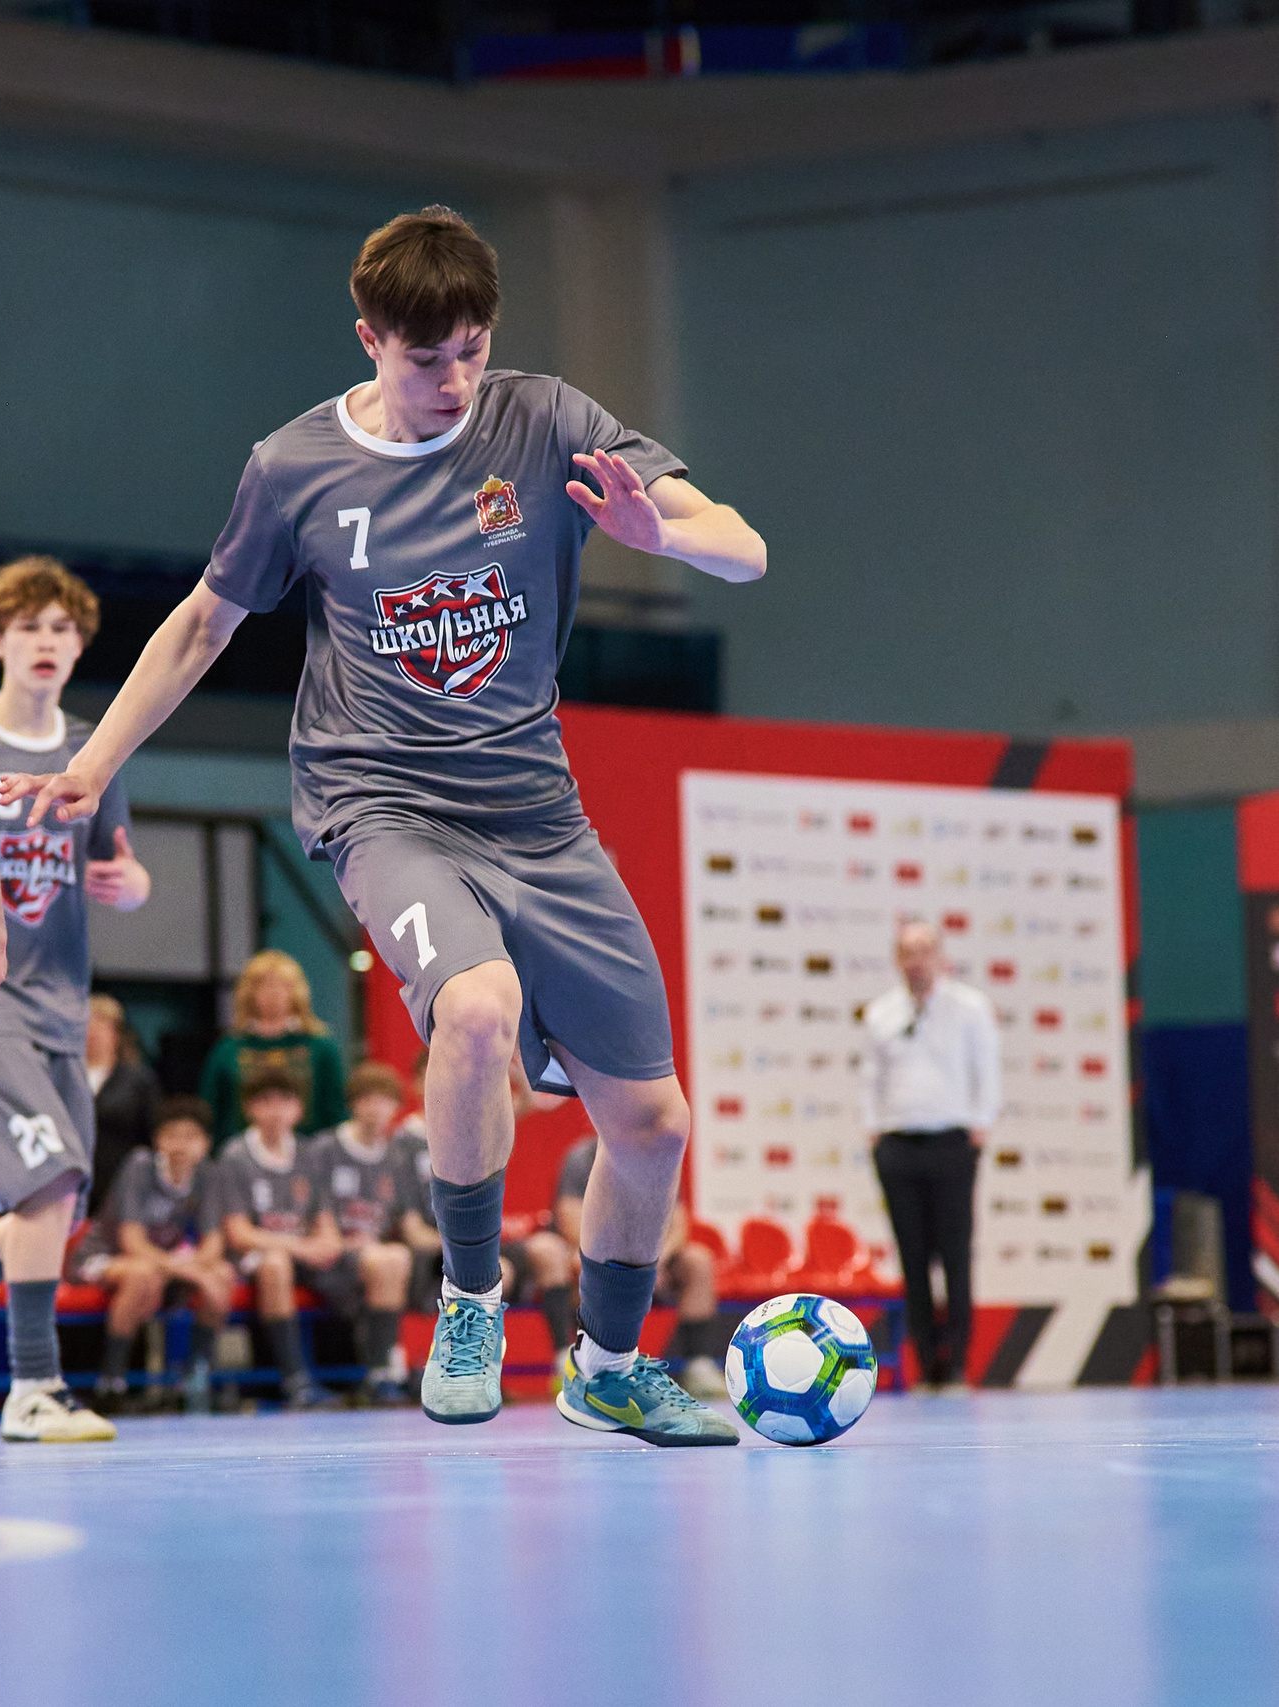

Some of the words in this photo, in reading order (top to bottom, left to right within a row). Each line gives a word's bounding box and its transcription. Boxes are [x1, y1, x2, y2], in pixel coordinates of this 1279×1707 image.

[337, 507, 371, 570] 7
[483, 532, 527, 548] ГУБЕРНАТОРА
[488, 528, 519, 540] КОМАНДА
[370, 594, 527, 656] ШКОЛЬНАЯ
[432, 609, 500, 676] Лига
[390, 902, 438, 971] 7
